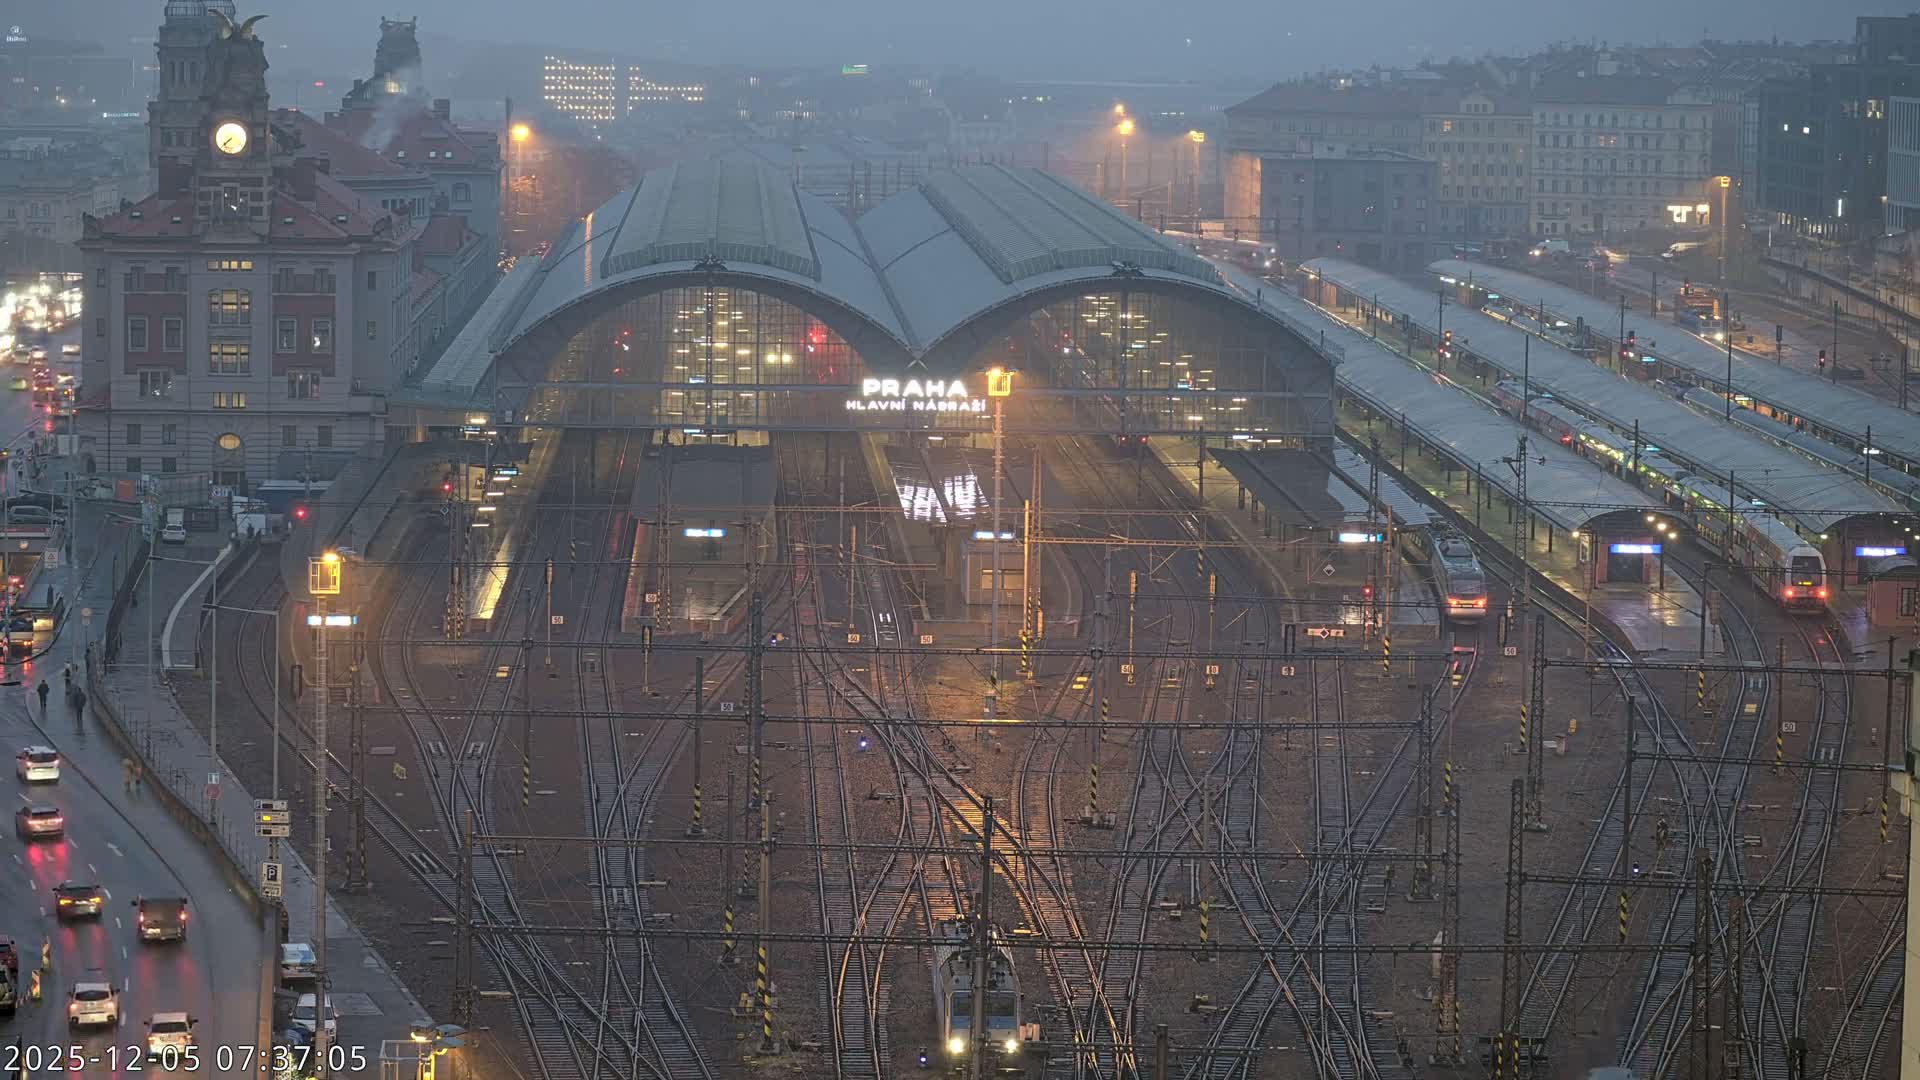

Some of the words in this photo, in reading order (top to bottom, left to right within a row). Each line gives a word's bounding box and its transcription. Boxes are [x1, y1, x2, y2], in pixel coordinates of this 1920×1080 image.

[863, 378, 968, 397] PRAHA
[846, 399, 906, 411] HLAVNÍ
[913, 398, 986, 411] NÁDRAŽÍ
[647, 594, 656, 602] 50
[553, 616, 562, 624] 50
[922, 635, 931, 643] 50
[1506, 646, 1515, 655] 50
[723, 703, 732, 711] 50
[1784, 722, 1793, 731] 50
[268, 868, 276, 879] P
